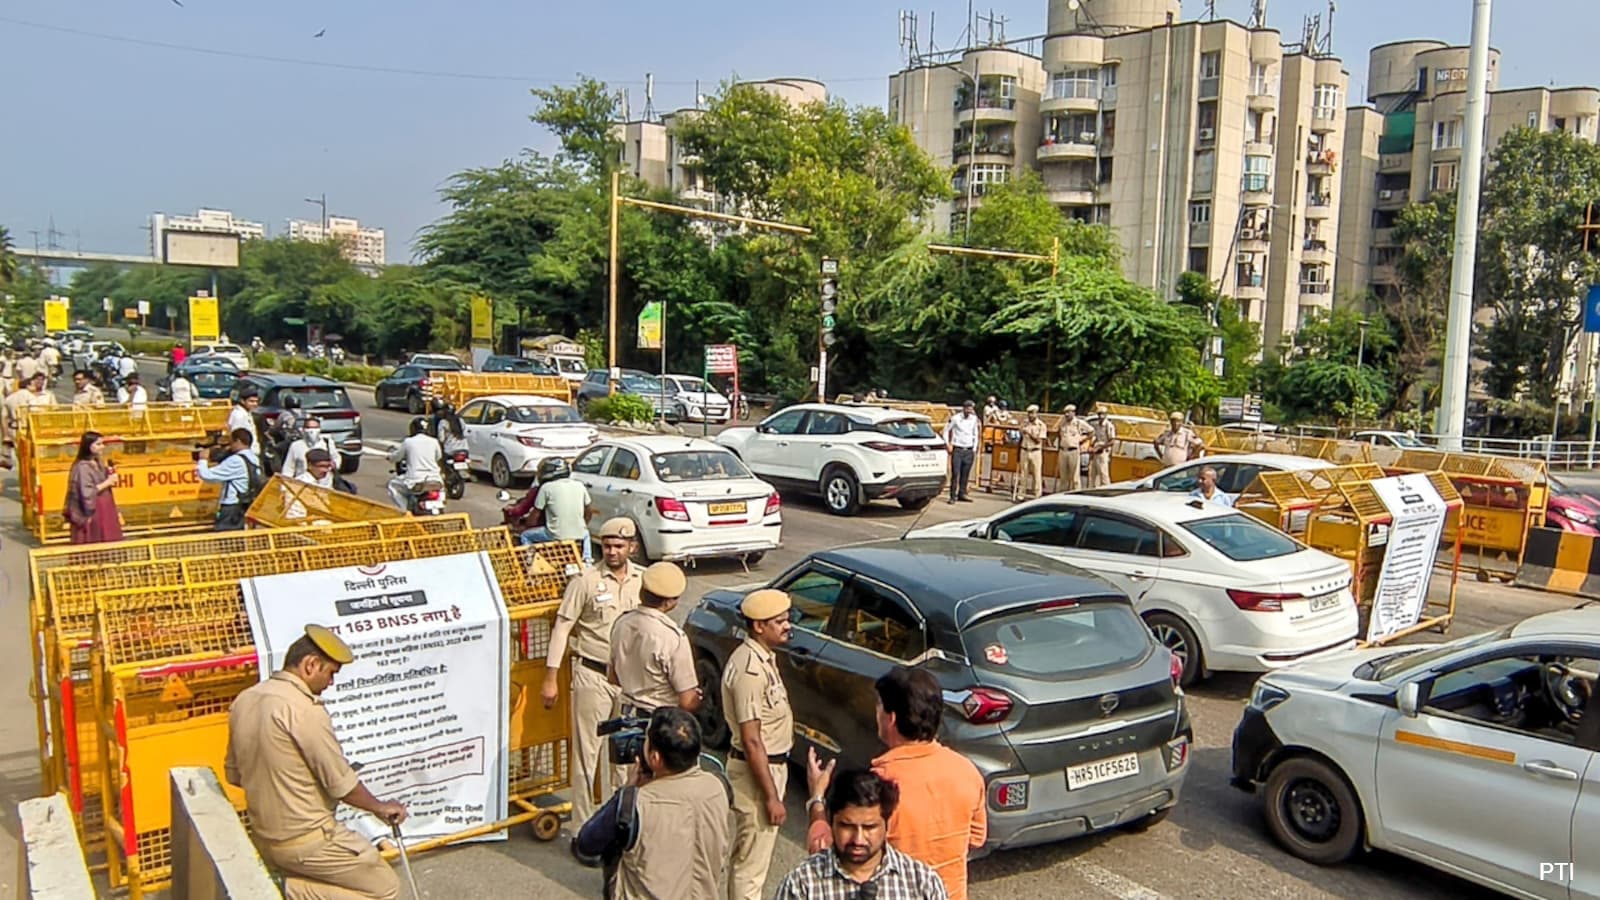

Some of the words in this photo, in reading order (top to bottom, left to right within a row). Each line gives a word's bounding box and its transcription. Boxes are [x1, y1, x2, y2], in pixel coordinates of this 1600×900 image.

[147, 470, 200, 486] POLICE
[344, 577, 376, 591] दिल्ली
[377, 575, 408, 590] पुलिस
[346, 619, 373, 633] 163
[377, 612, 418, 629] BNSS
[421, 609, 453, 623] लागू
[450, 605, 462, 620] है
[1074, 757, 1137, 783] HR51CF5626
